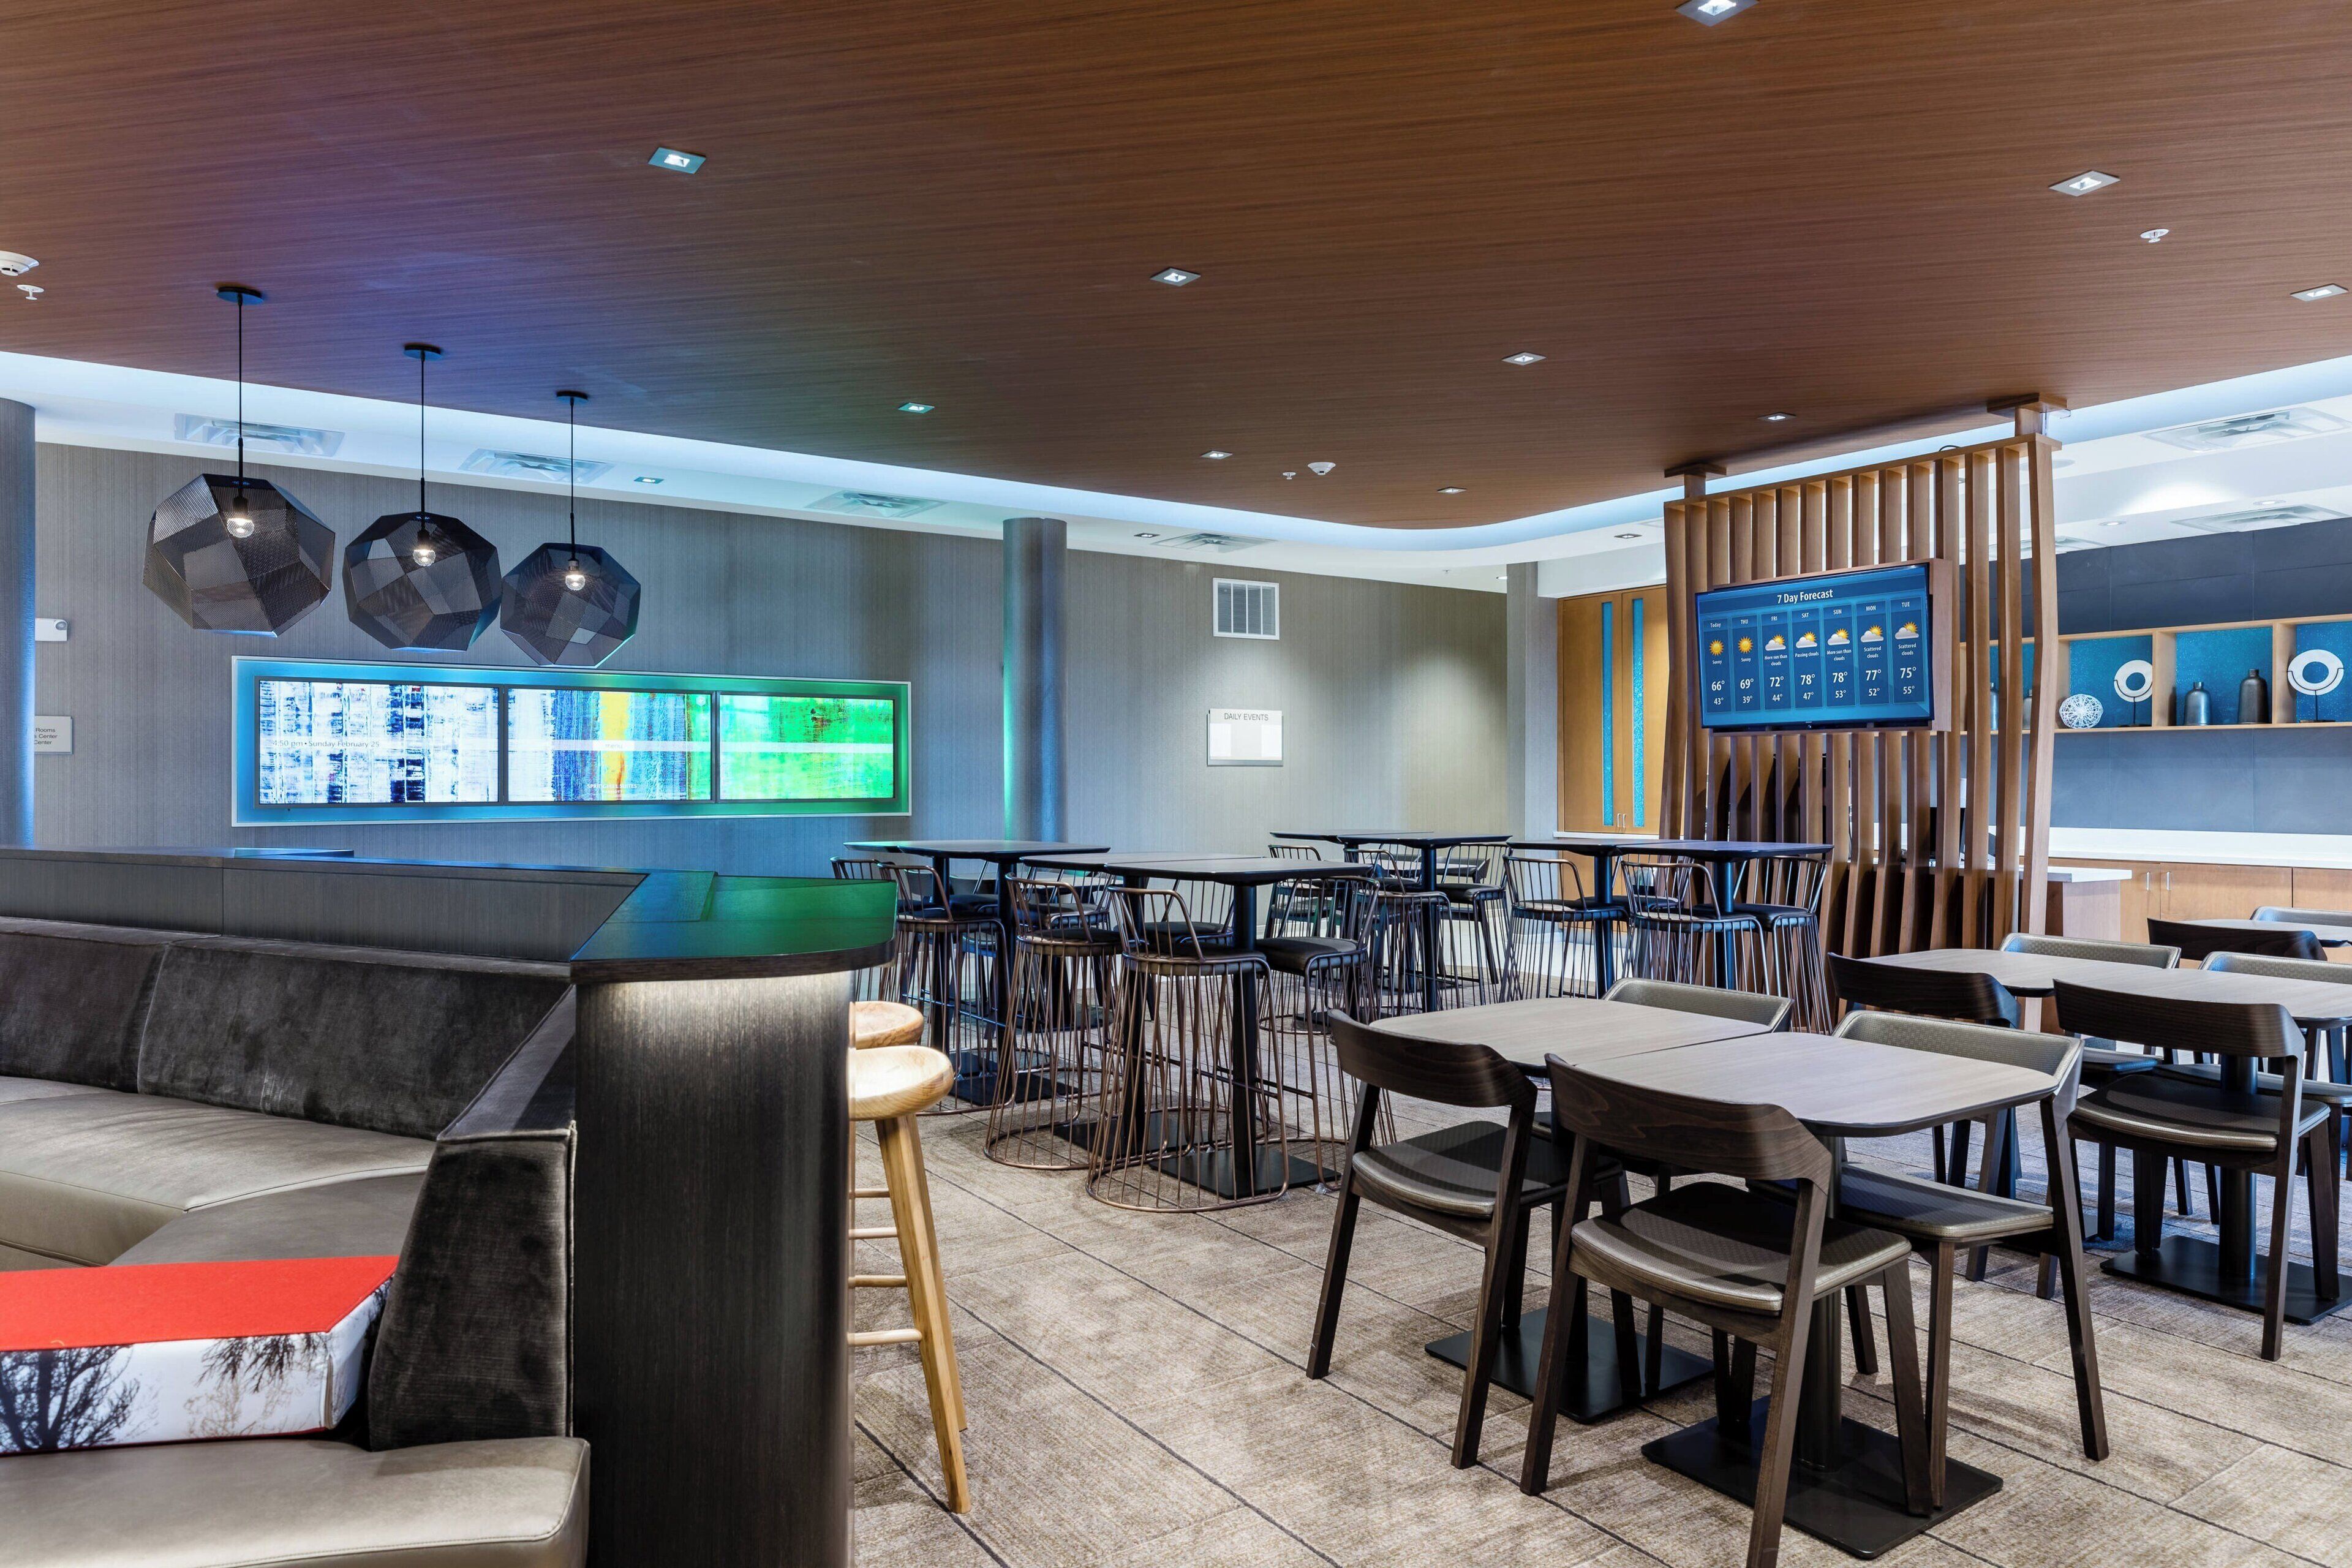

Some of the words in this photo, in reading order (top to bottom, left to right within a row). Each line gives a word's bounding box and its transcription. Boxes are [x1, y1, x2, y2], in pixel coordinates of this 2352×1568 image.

[1777, 595, 1782, 604] 7
[1784, 594, 1798, 604] Day
[1800, 589, 1833, 601] Forecast
[1833, 671, 1847, 683] 78°
[1866, 669, 1882, 681] 77°
[1900, 666, 1917, 679] 75°
[1740, 678, 1754, 689] 69°
[1770, 676, 1784, 687] 72°
[1801, 674, 1815, 685] 78°
[1711, 680, 1725, 691] 66°
[1903, 686, 1915, 695] 55°
[1835, 690, 1846, 698] 53°
[1868, 688, 1880, 696] 52°
[1743, 695, 1752, 704] 39°
